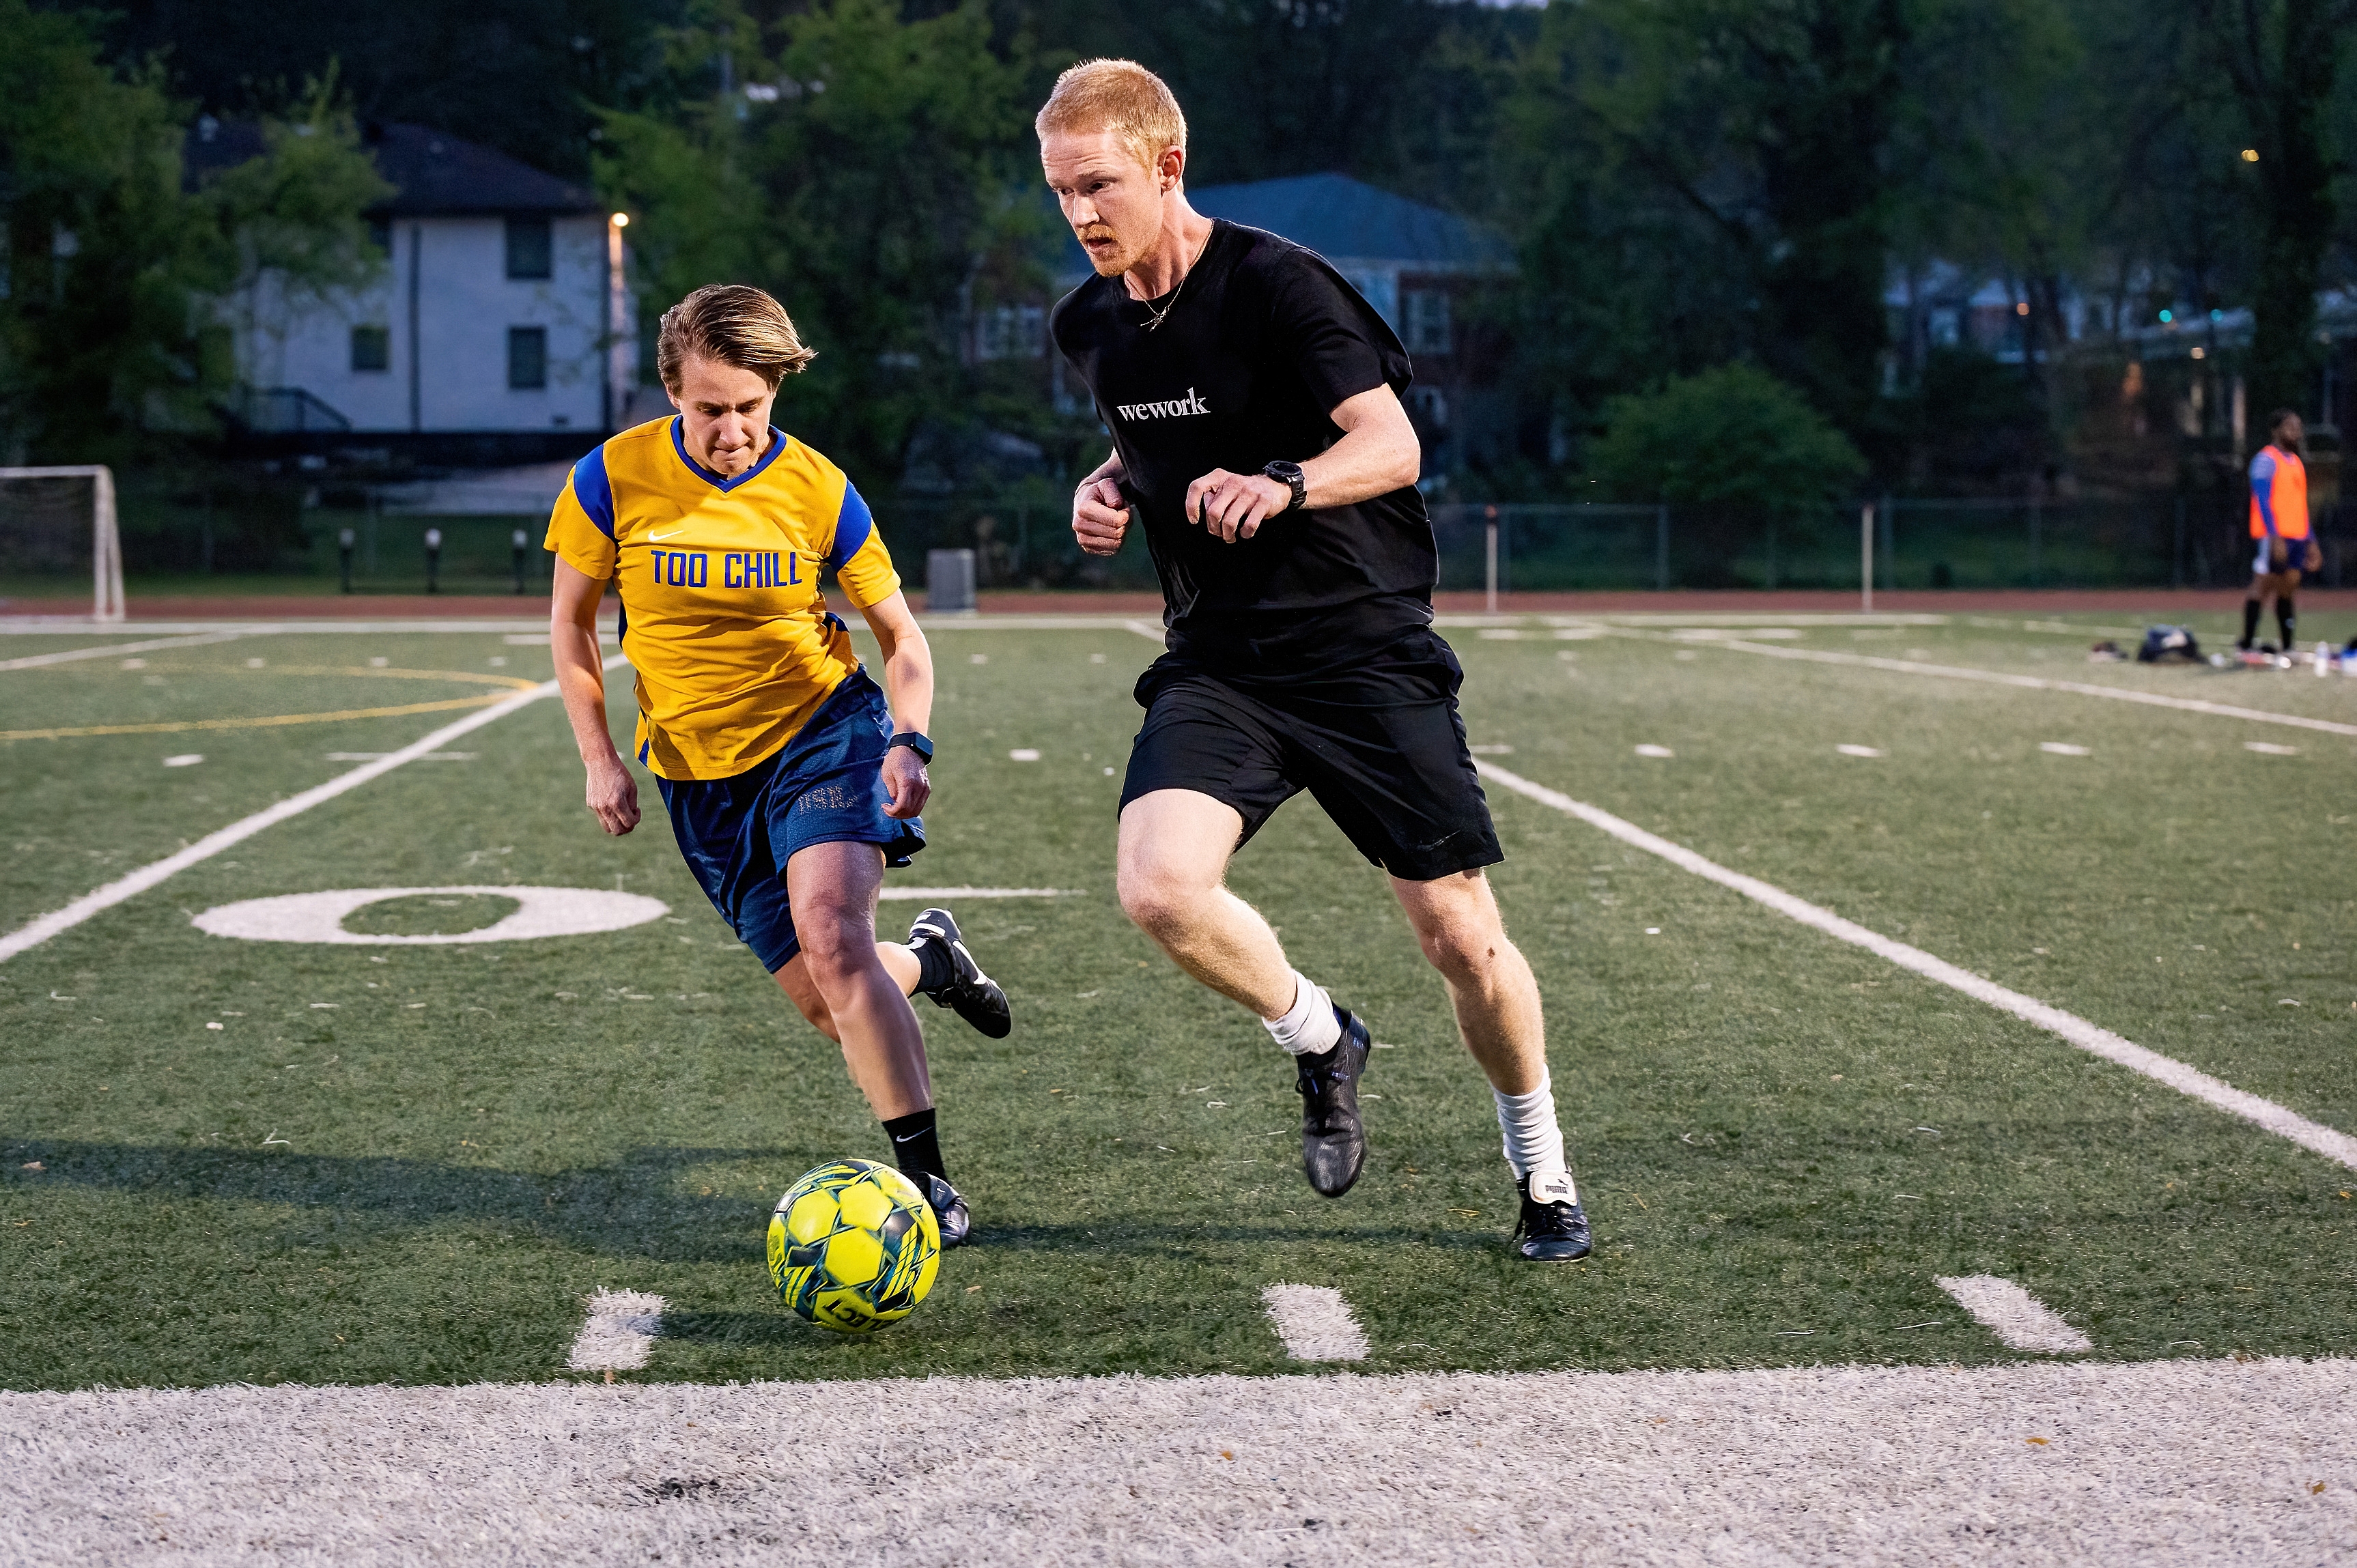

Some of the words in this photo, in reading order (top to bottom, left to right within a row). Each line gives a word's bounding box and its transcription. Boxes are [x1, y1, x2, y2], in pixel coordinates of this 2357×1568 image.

[1116, 386, 1211, 421] wework
[650, 550, 708, 588] TOO
[724, 551, 803, 589] CHILL
